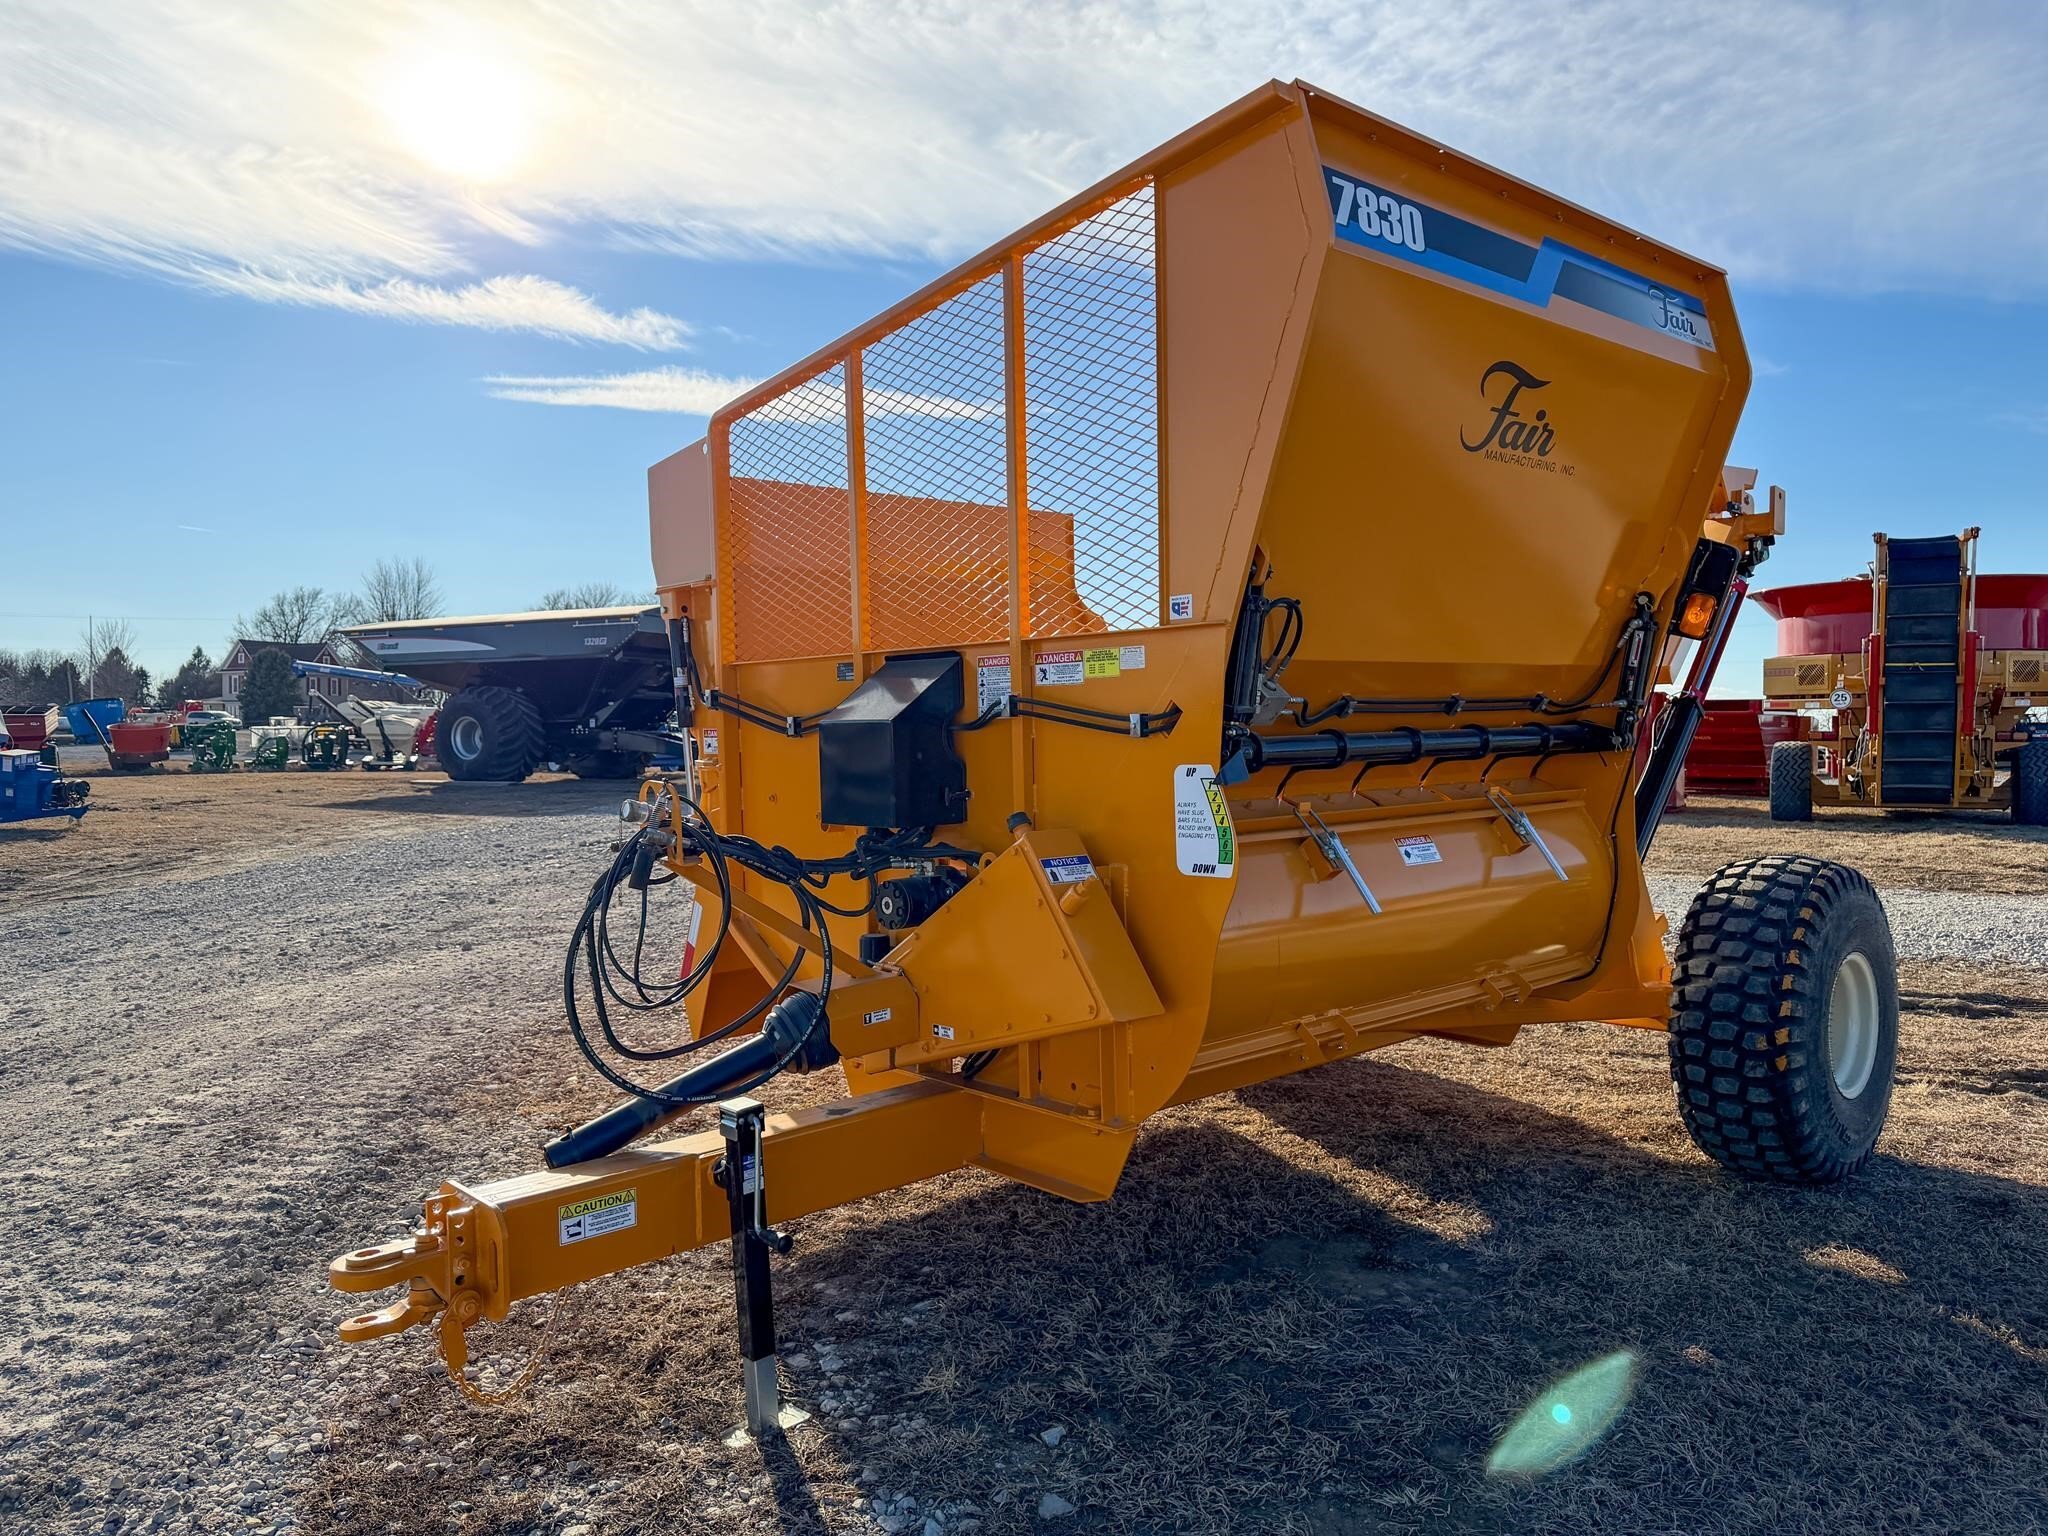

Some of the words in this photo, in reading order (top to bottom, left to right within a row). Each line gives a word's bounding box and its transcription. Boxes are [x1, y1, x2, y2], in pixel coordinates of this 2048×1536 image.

[1331, 175, 1426, 253] 7830
[1648, 285, 1697, 336] Fair
[1460, 360, 1556, 457] Fair
[1560, 463, 1577, 477] INC.
[984, 657, 1010, 666] DANGER
[1042, 652, 1076, 663] DANGER
[1834, 693, 1848, 702] 25
[1186, 767, 1197, 777] UP
[1212, 792, 1218, 802] 2
[1215, 804, 1222, 814] 3
[1219, 816, 1225, 826] 4
[1221, 828, 1227, 838] 5
[1222, 840, 1228, 850] 6
[1050, 857, 1080, 867] NOTICE
[1223, 852, 1229, 862] 7
[1192, 863, 1217, 875] DOWN
[574, 1194, 622, 1215] CAUTION
